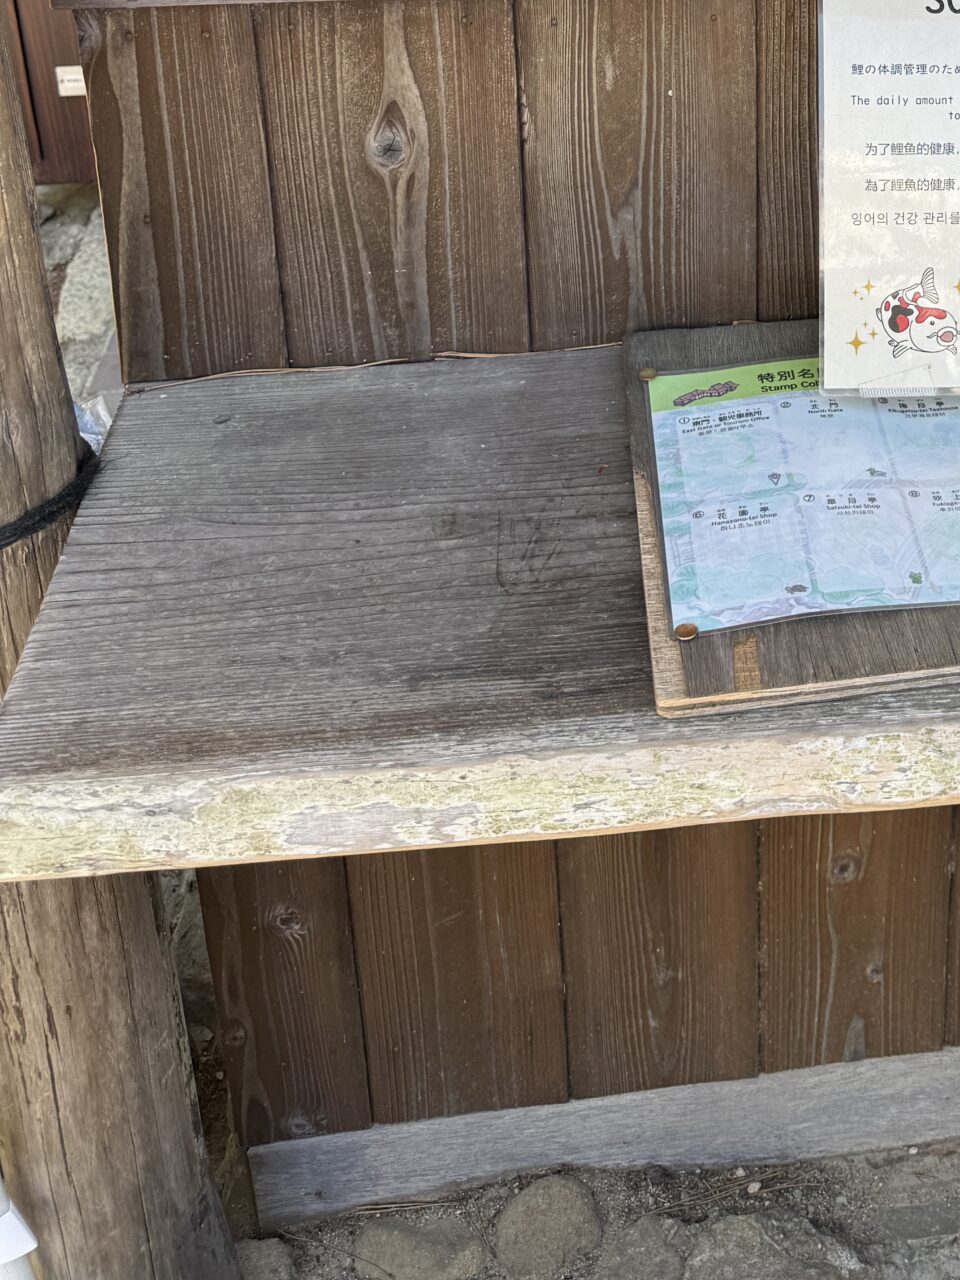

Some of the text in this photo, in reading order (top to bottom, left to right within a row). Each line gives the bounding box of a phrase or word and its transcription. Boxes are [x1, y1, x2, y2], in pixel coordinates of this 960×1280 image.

[850, 95, 870, 106] The
[876, 94, 909, 107] daily
[915, 95, 954, 106] amount
[948, 111, 960, 121] to
[851, 212, 889, 227] 잉어의
[893, 212, 918, 226] 건강
[922, 211, 960, 225] 관리를
[757, 368, 820, 384] 特別名
[761, 383, 798, 393] Stamp
